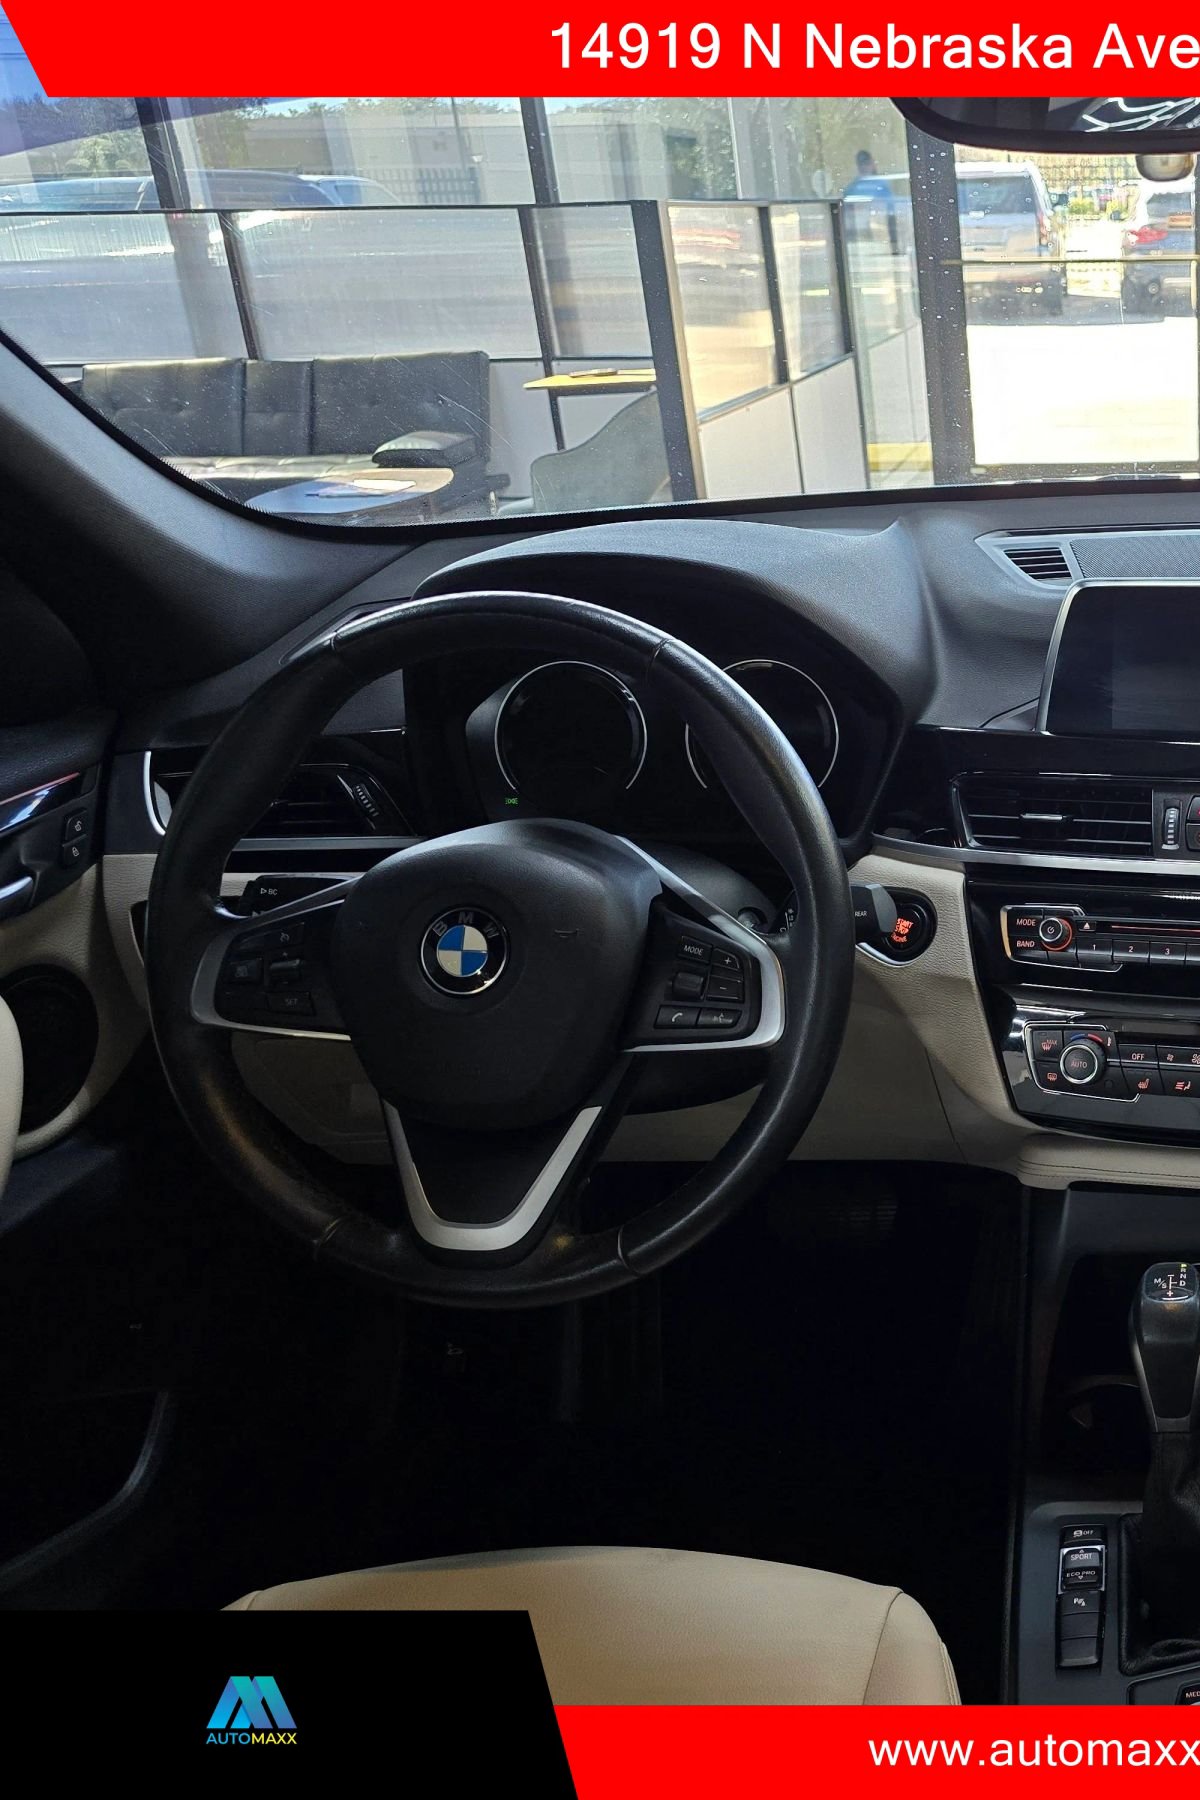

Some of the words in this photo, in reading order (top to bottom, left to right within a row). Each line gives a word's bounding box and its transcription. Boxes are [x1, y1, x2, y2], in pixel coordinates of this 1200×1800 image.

[432, 911, 499, 938] BMW
[1016, 918, 1036, 927] MODE
[1016, 940, 1035, 949] BAND
[1128, 945, 1134, 953] 2
[683, 944, 704, 956] MODE
[1165, 947, 1170, 956] 3
[1131, 1053, 1145, 1061] OFF
[1070, 1061, 1087, 1069] AUTO
[1070, 1552, 1093, 1561] SPORT
